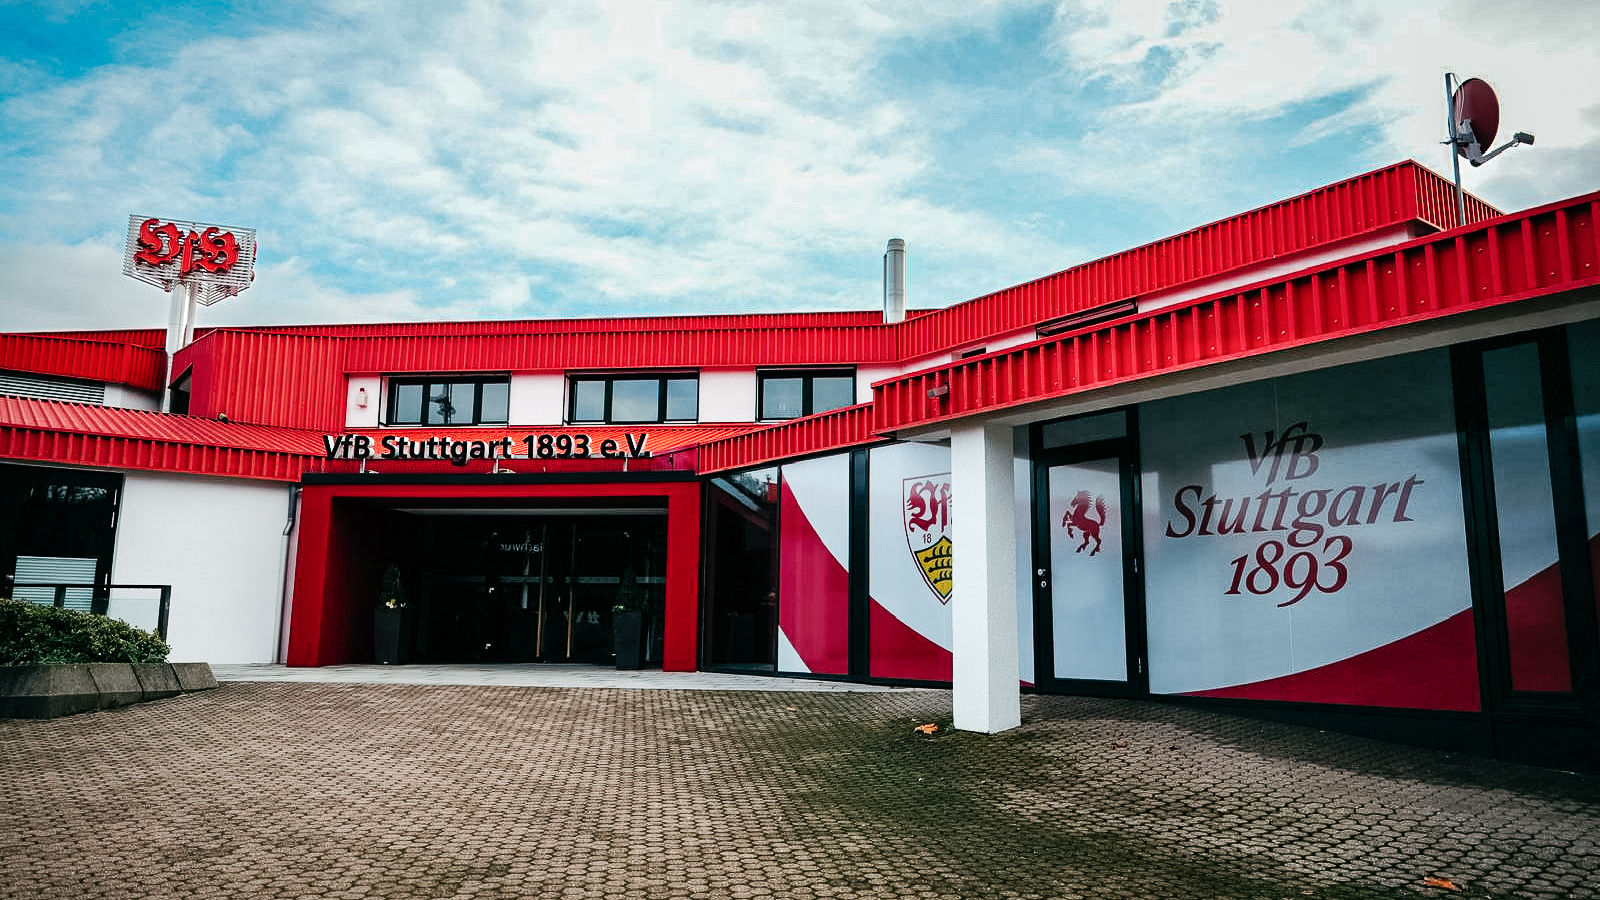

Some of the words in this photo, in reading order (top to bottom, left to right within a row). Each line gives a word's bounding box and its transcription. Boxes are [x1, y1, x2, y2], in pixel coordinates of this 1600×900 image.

[323, 434, 374, 459] VfB
[380, 434, 513, 466] Stuttgart
[522, 434, 592, 459] 1893
[600, 433, 653, 459] e.V.
[1240, 422, 1324, 487] VfB
[906, 480, 952, 533] Vf
[1165, 474, 1424, 548] Stuttgart
[922, 533, 932, 544] 18
[1223, 535, 1353, 608] 1893
